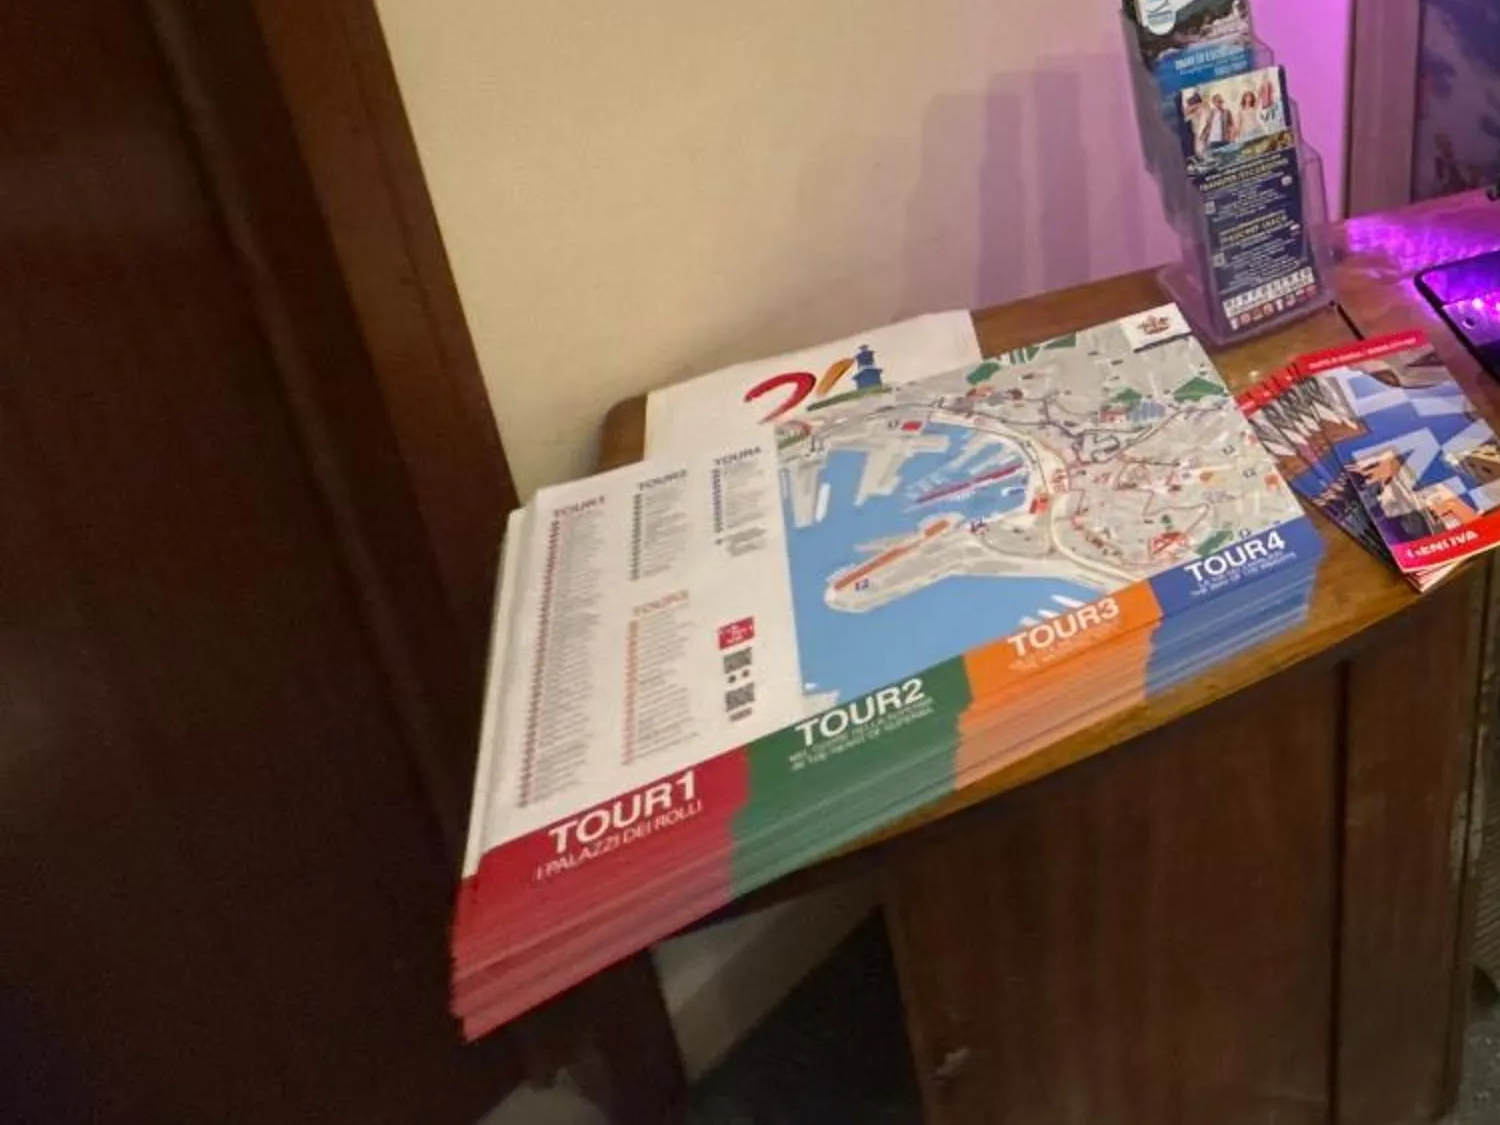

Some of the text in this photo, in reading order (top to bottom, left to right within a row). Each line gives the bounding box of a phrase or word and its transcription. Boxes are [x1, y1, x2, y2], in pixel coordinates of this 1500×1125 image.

[1184, 531, 1287, 582] TOUR4
[1007, 599, 1121, 658] TOUR3
[794, 677, 925, 747] TOUR2
[545, 835, 620, 876] PALAZZI
[623, 821, 652, 844] DEI
[655, 798, 703, 830] ROLLI
[548, 769, 696, 854] TOUR1
